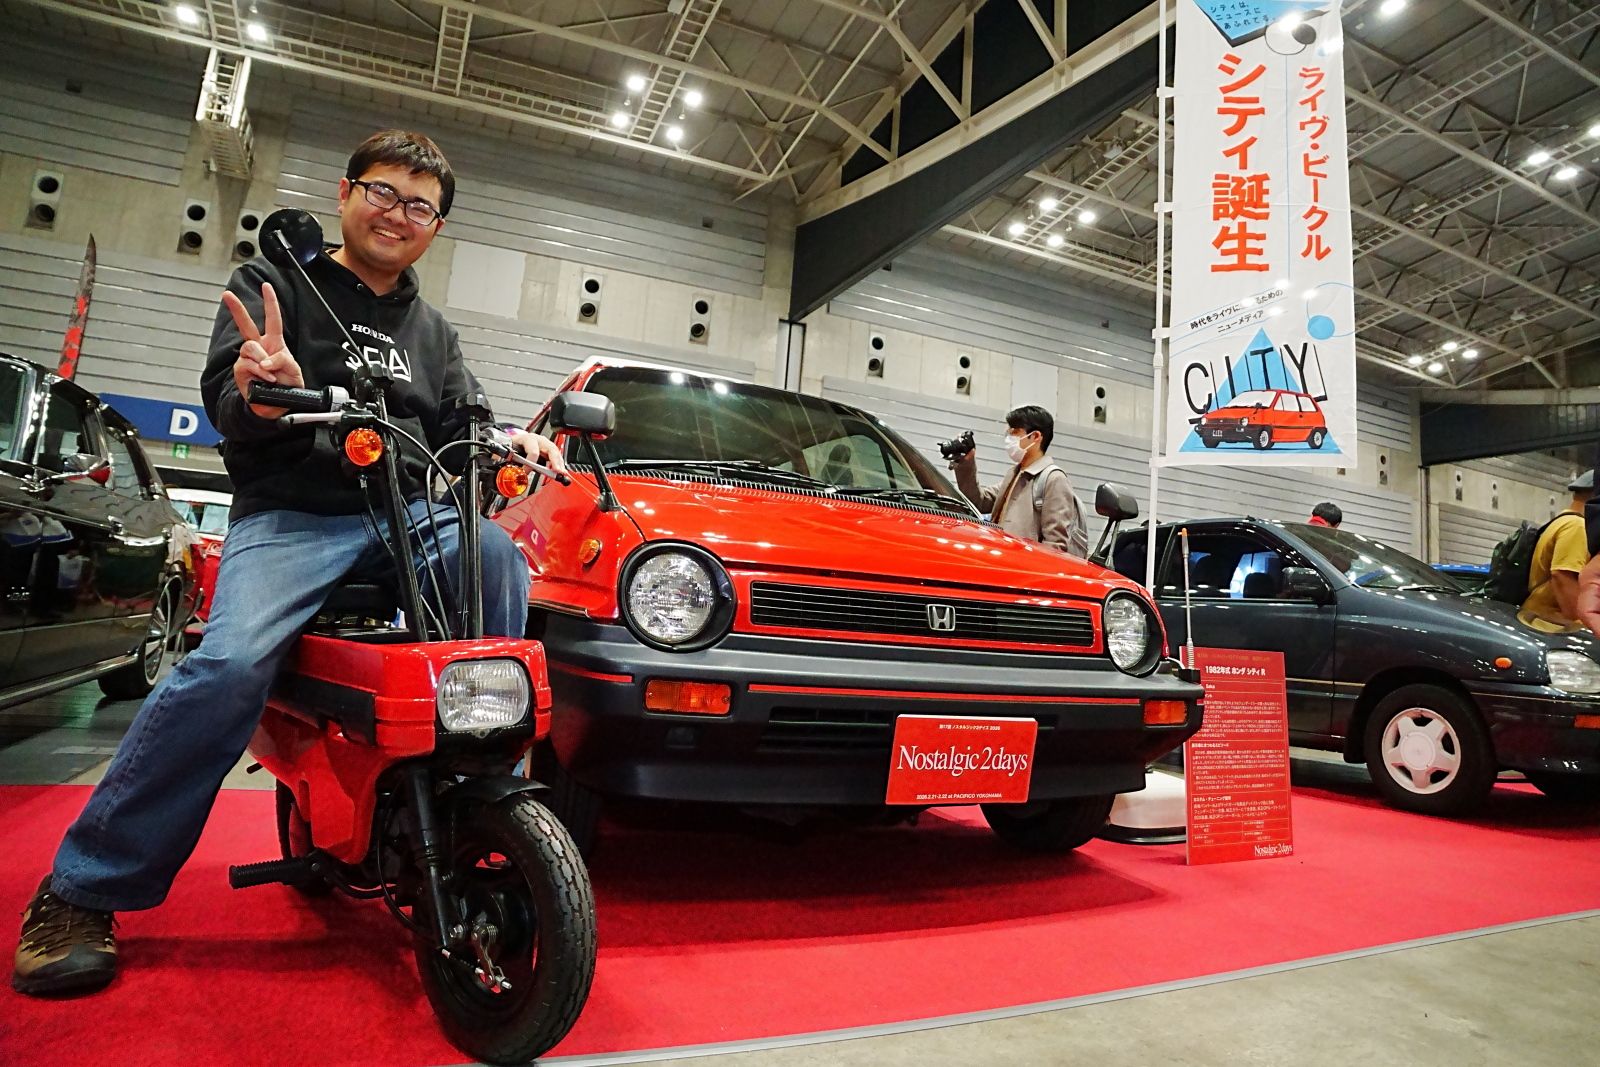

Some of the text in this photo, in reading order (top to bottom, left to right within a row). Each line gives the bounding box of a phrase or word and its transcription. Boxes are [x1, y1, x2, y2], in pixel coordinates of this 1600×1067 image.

[1211, 53, 1271, 273] シティ誕生
[1298, 66, 1332, 262] ライヴ・ビークル
[351, 323, 396, 344] HONDA
[1183, 342, 1326, 422] CITY
[169, 408, 198, 436] D
[1205, 665, 1231, 675] 1982年式
[1231, 667, 1246, 675] ホンダ
[1247, 668, 1261, 676] シティ
[897, 745, 1028, 777] Nostalgic 2days
